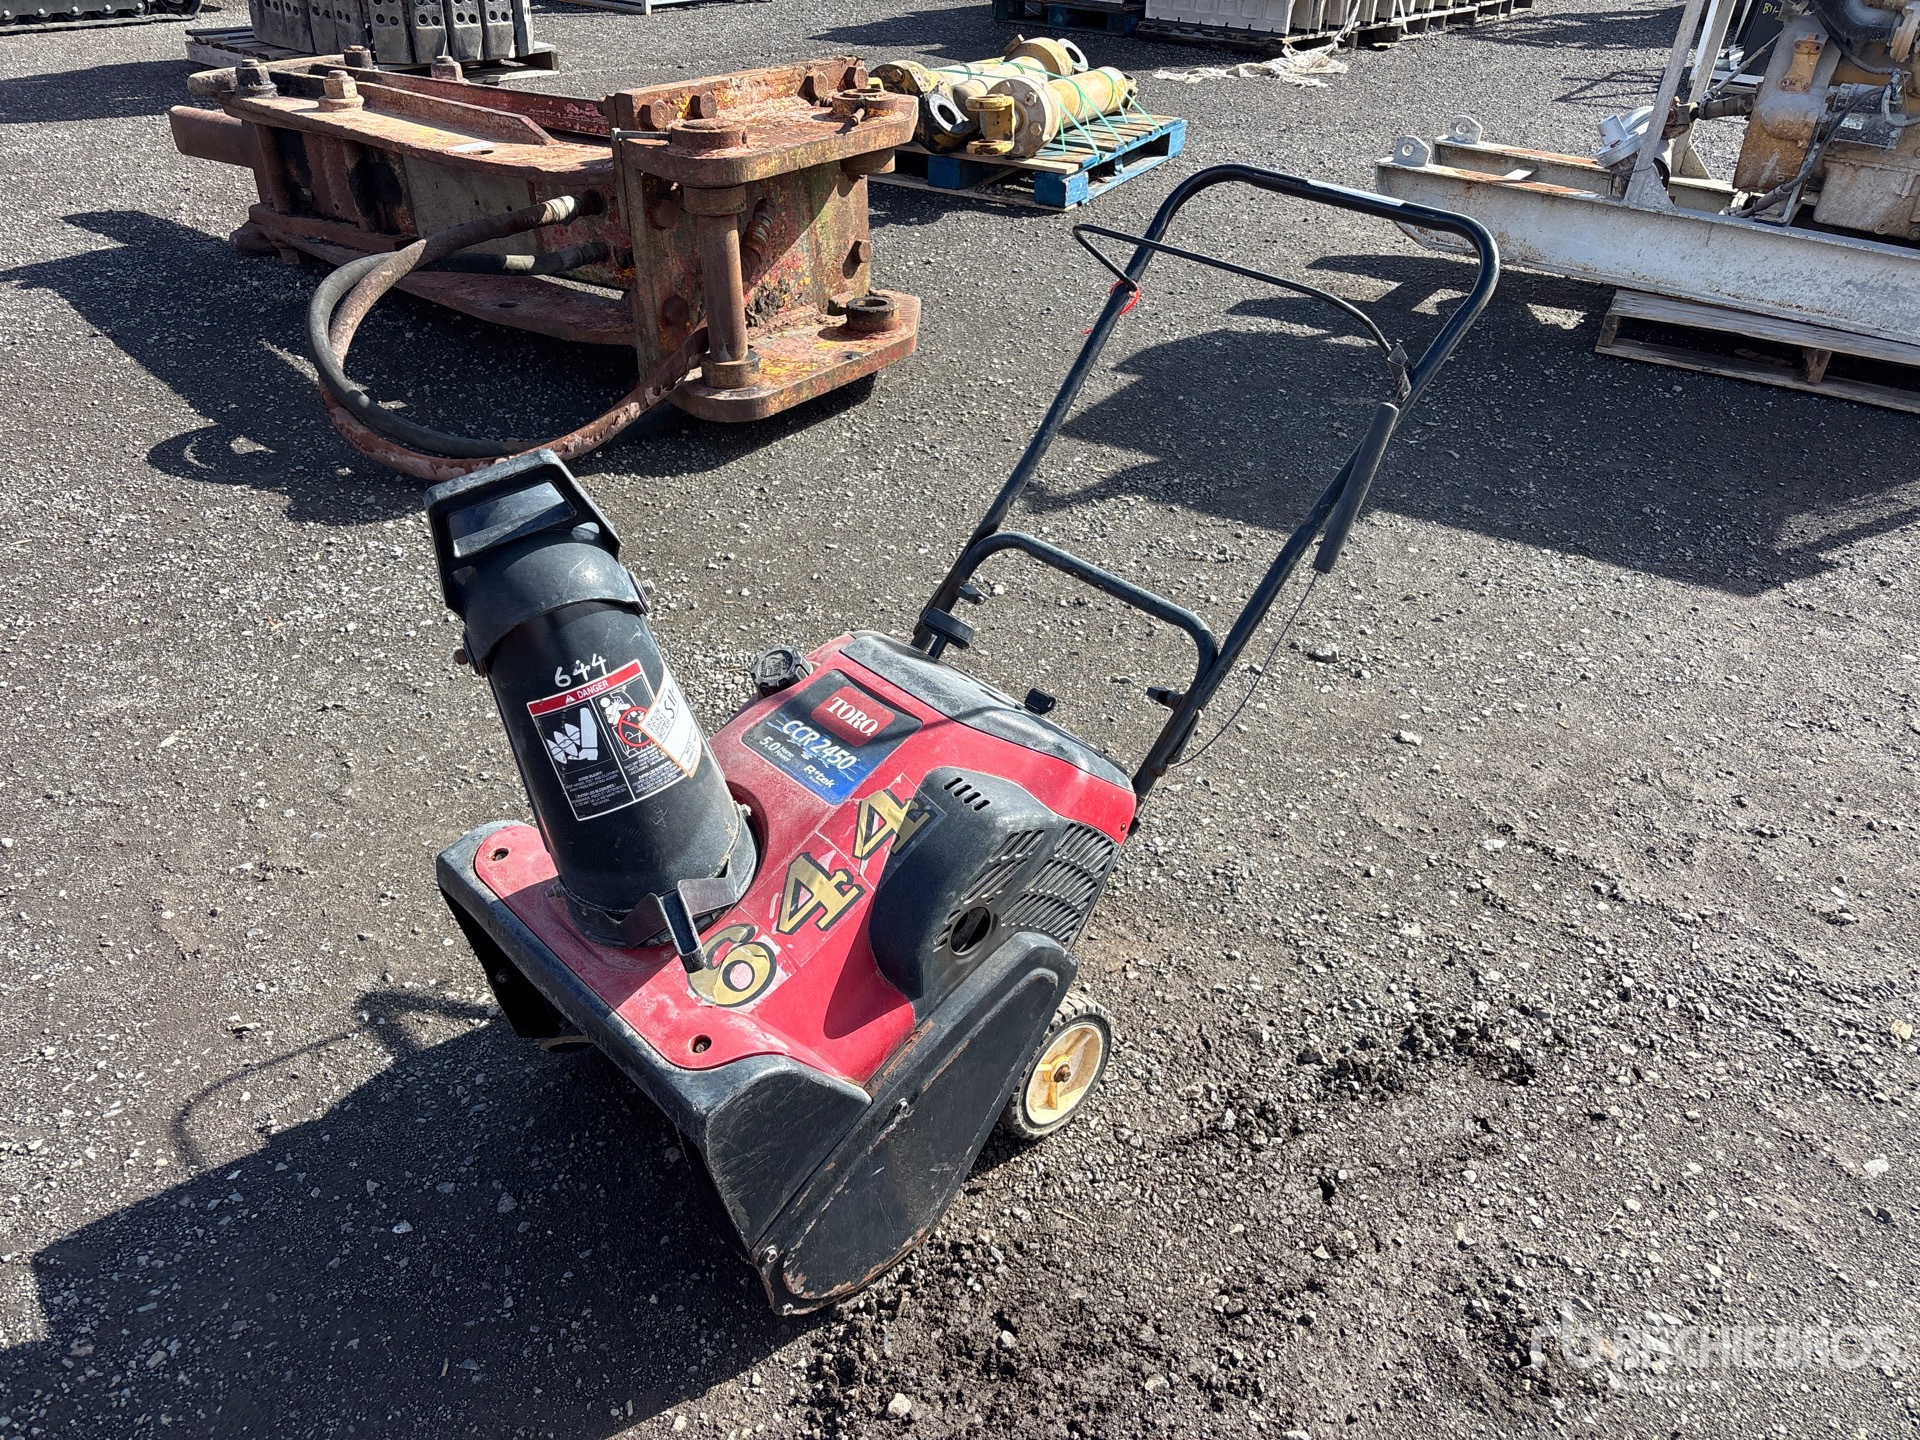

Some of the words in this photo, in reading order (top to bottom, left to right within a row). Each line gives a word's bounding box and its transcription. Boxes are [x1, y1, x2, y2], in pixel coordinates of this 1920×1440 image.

[554, 653, 607, 688] 644
[576, 680, 610, 700] DANGER
[825, 696, 879, 736] TORO
[759, 736, 780, 752] 5.0
[782, 720, 821, 746] CCR
[810, 738, 858, 769] 2450
